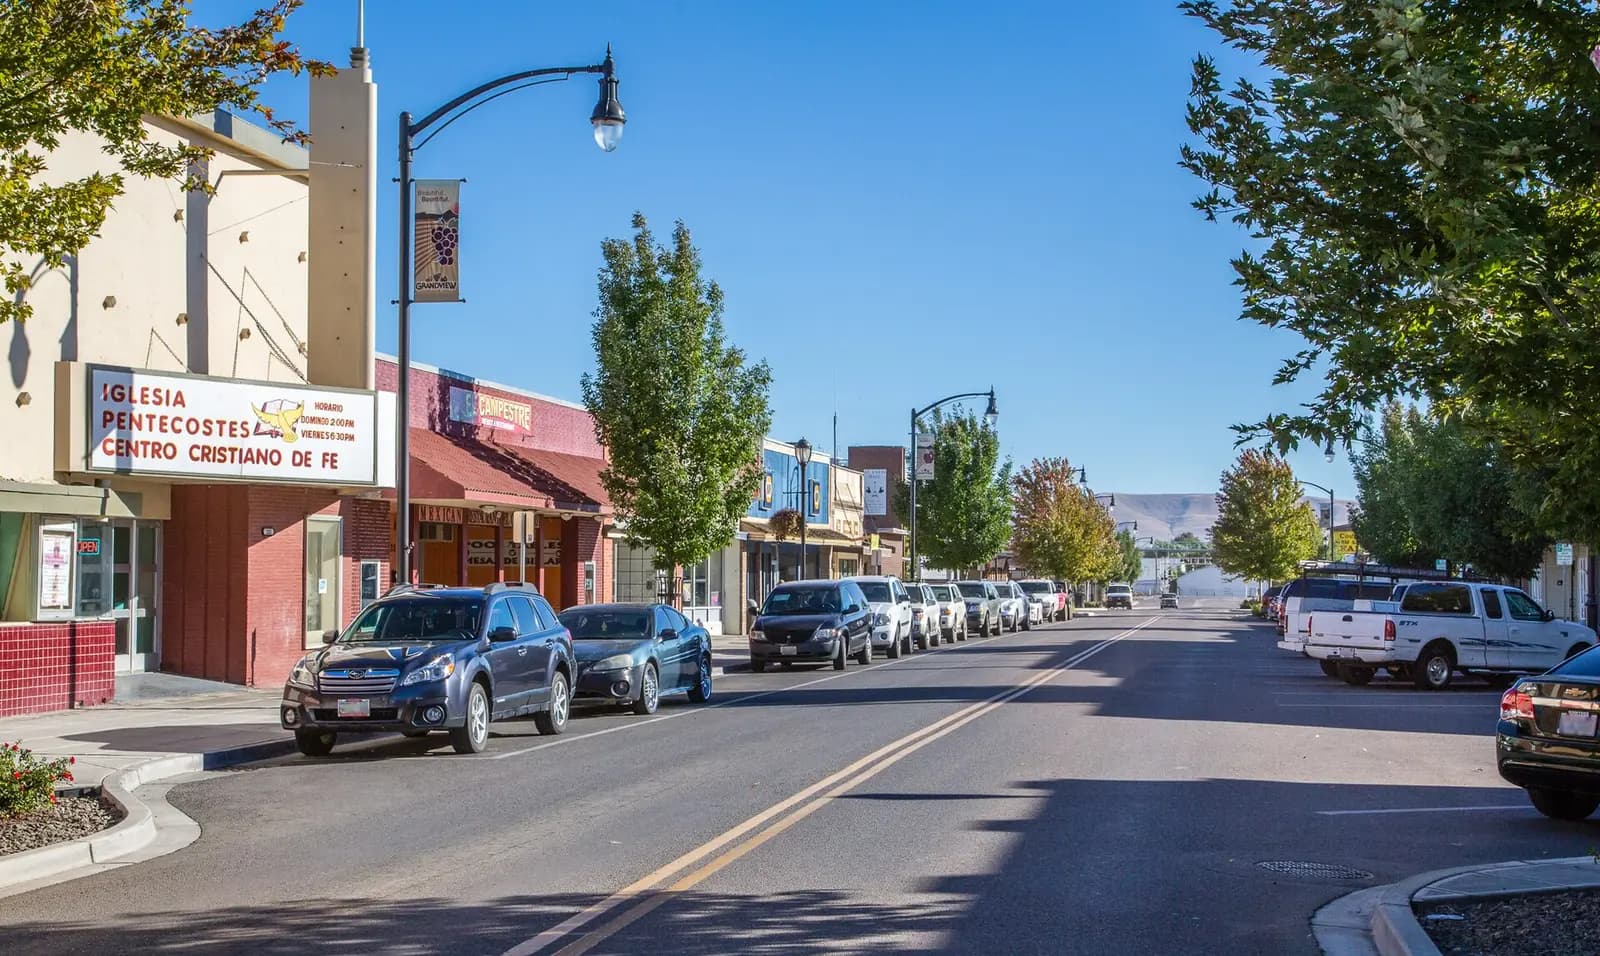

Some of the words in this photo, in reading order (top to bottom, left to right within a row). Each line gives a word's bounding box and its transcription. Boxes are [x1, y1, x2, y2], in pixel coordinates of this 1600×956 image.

[416, 282, 456, 290] GRANDVIEW
[102, 383, 186, 408] IGLESIA
[314, 402, 343, 413] HORARIO
[479, 396, 531, 432] CAMPESTRE
[102, 410, 250, 439] PENTECOSTES
[301, 415, 329, 426] DOMINGO
[301, 429, 330, 440] VIERNES
[102, 438, 177, 460] CENTRO
[188, 444, 282, 466] CRISTIANO
[291, 450, 312, 468] DE
[321, 452, 339, 470] FE
[420, 505, 463, 523] MEXICAN
[76, 542, 97, 552] OPEN
